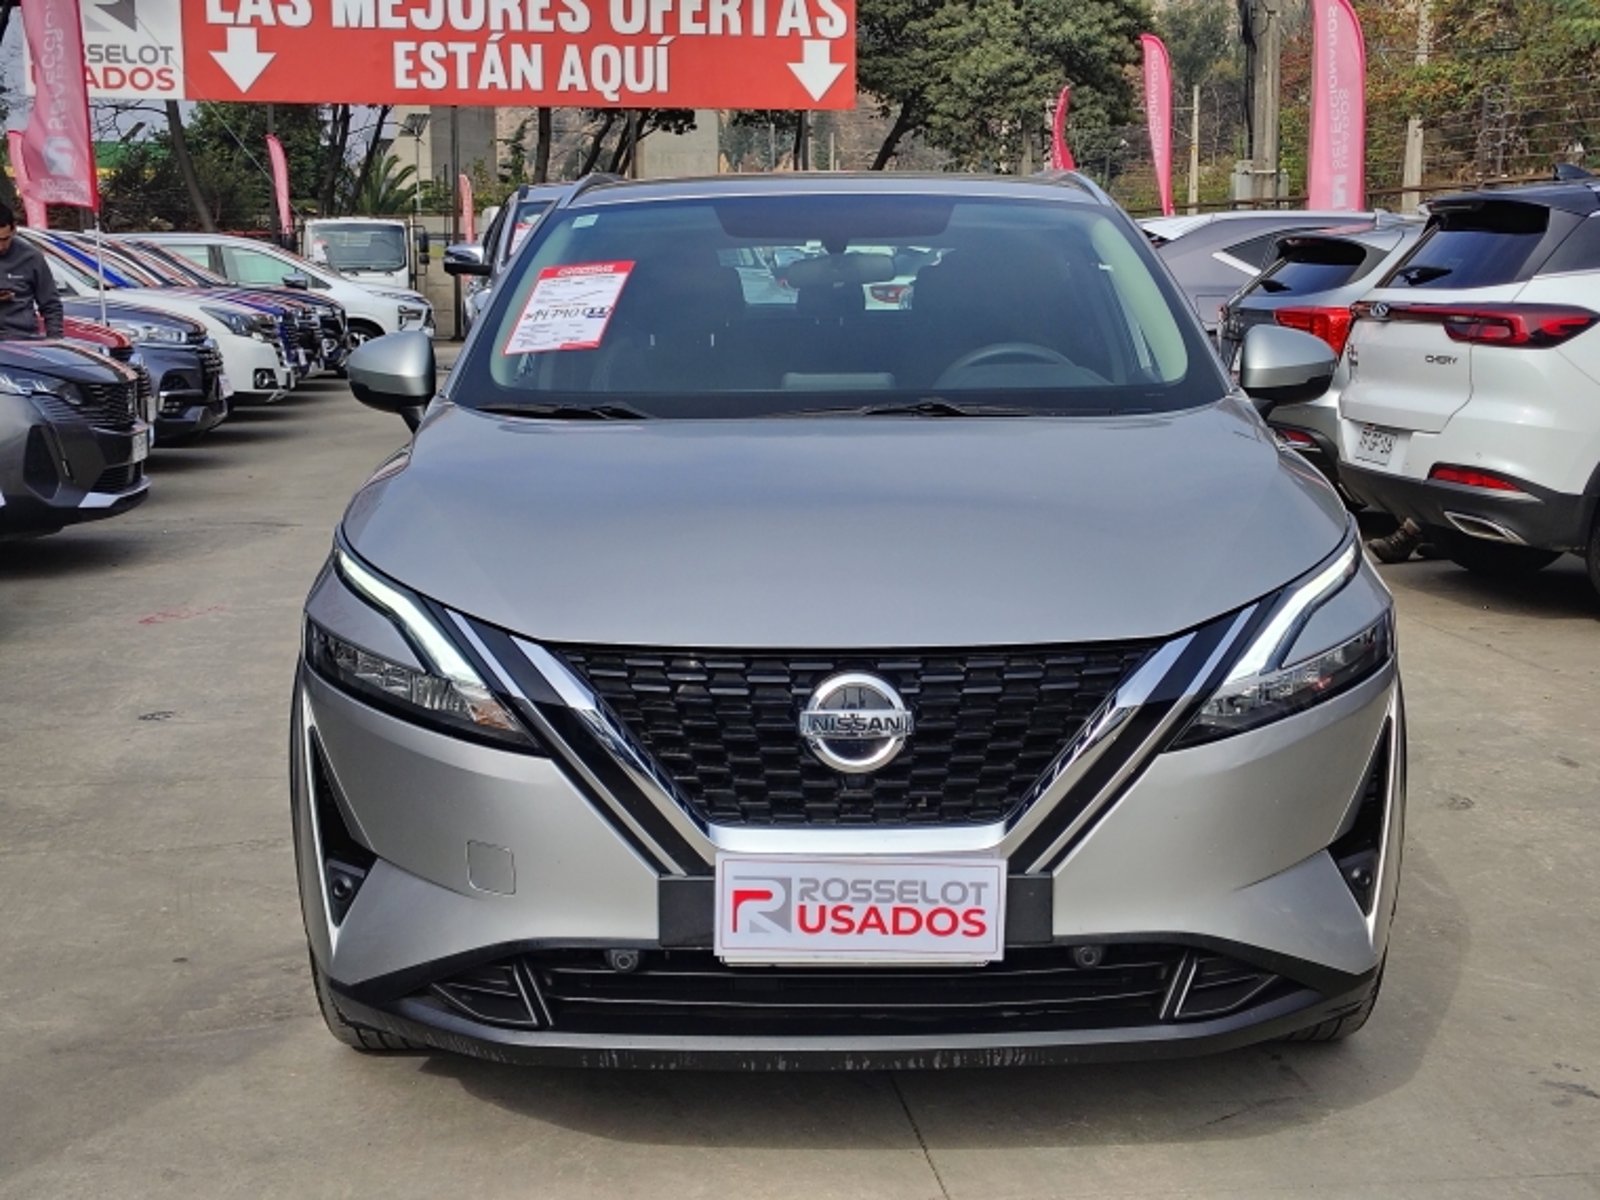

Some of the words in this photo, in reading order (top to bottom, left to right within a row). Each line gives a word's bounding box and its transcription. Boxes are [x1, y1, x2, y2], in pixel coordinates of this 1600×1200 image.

[205, 0, 312, 27] LAS
[331, 0, 590, 33] MEJORES
[608, 0, 848, 38] OFERTAS
[87, 43, 174, 66] SELOT
[393, 32, 543, 90] ESTÁN
[557, 35, 676, 101] AQUÍ
[1424, 355, 1458, 365] CHERY
[807, 716, 900, 731] NISSAN
[799, 877, 988, 906] ROSSELOT
[797, 904, 987, 937] USADOS
